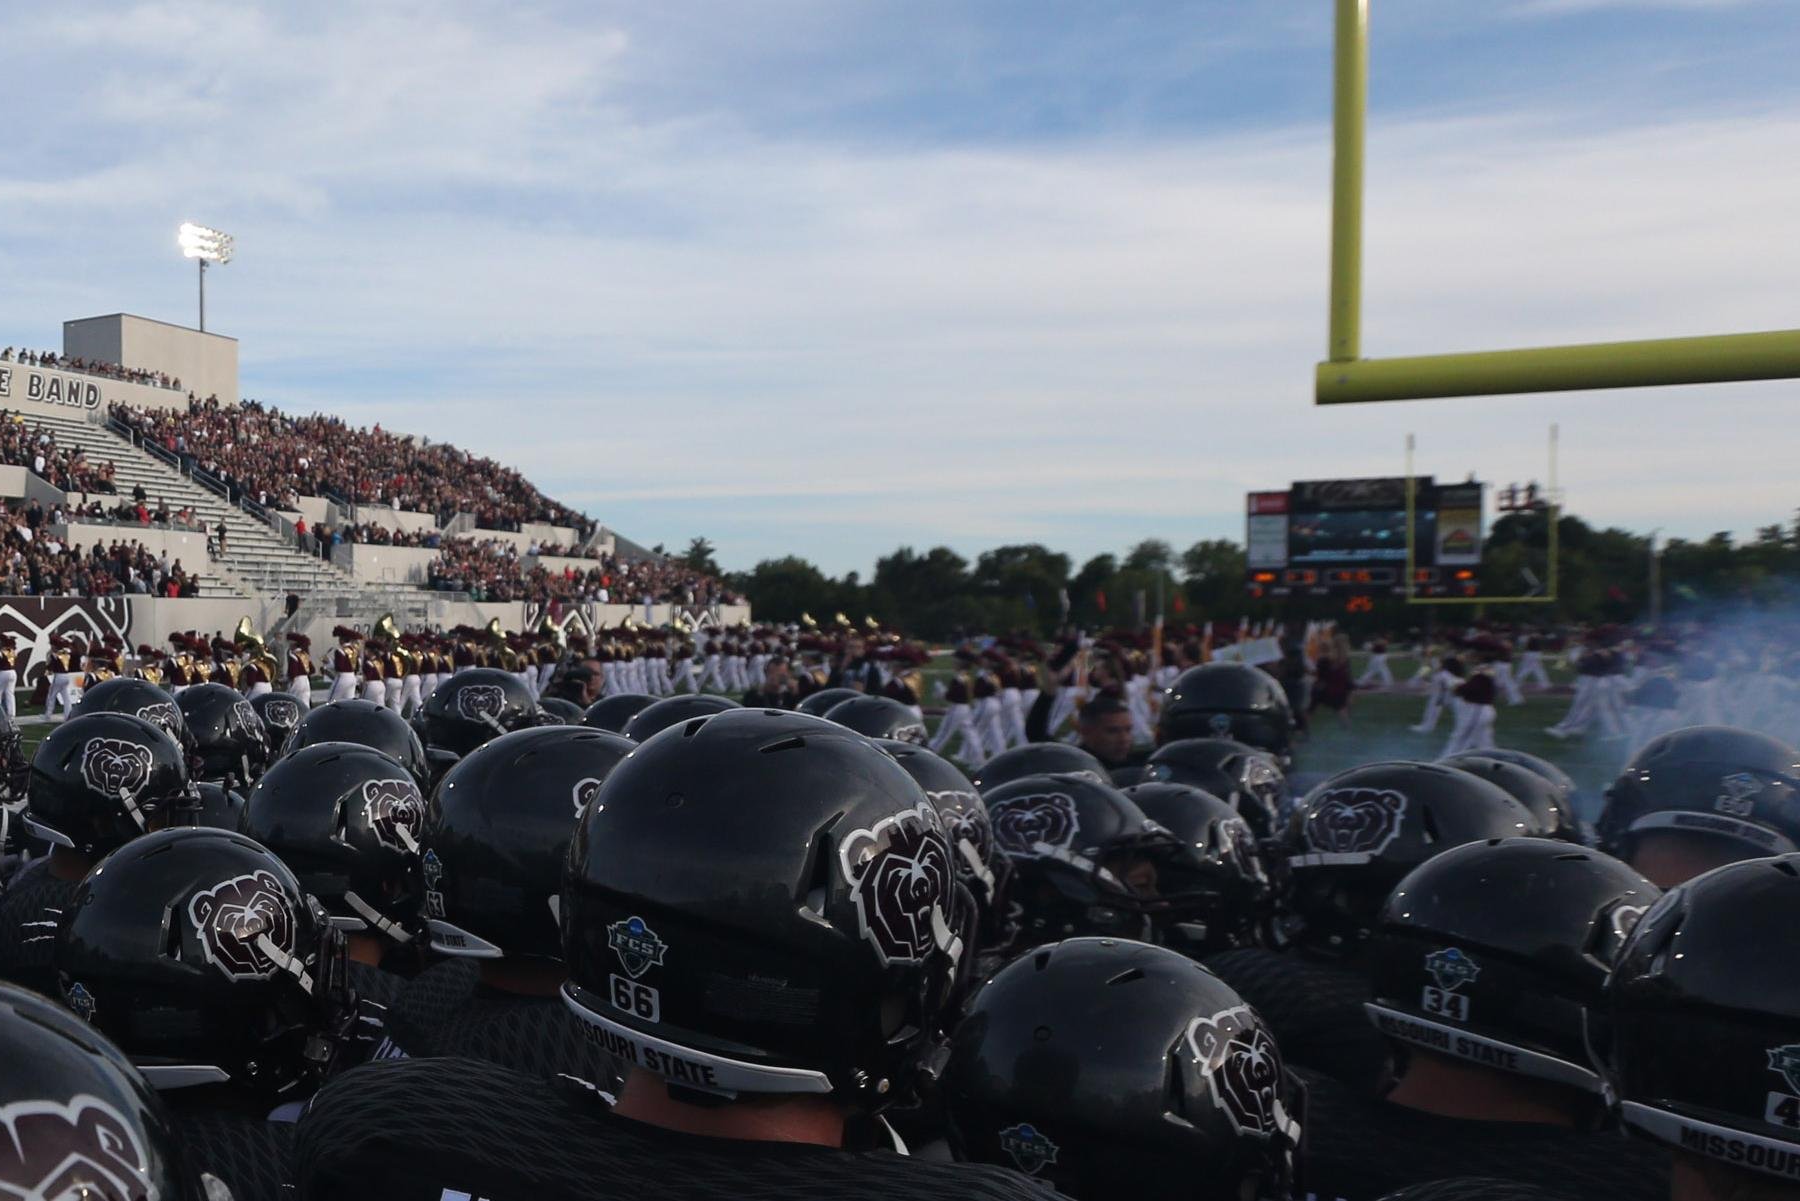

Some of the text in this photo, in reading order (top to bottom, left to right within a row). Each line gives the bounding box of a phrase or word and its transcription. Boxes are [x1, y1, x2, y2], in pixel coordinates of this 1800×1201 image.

[27, 371, 101, 409] BAND
[615, 933, 655, 955] FCS
[613, 977, 654, 1019] 66
[1427, 988, 1462, 1020] 34
[644, 1047, 718, 1086] STATE
[1456, 1037, 1519, 1069] STATE
[1680, 1125, 1800, 1176] MISSOUR
